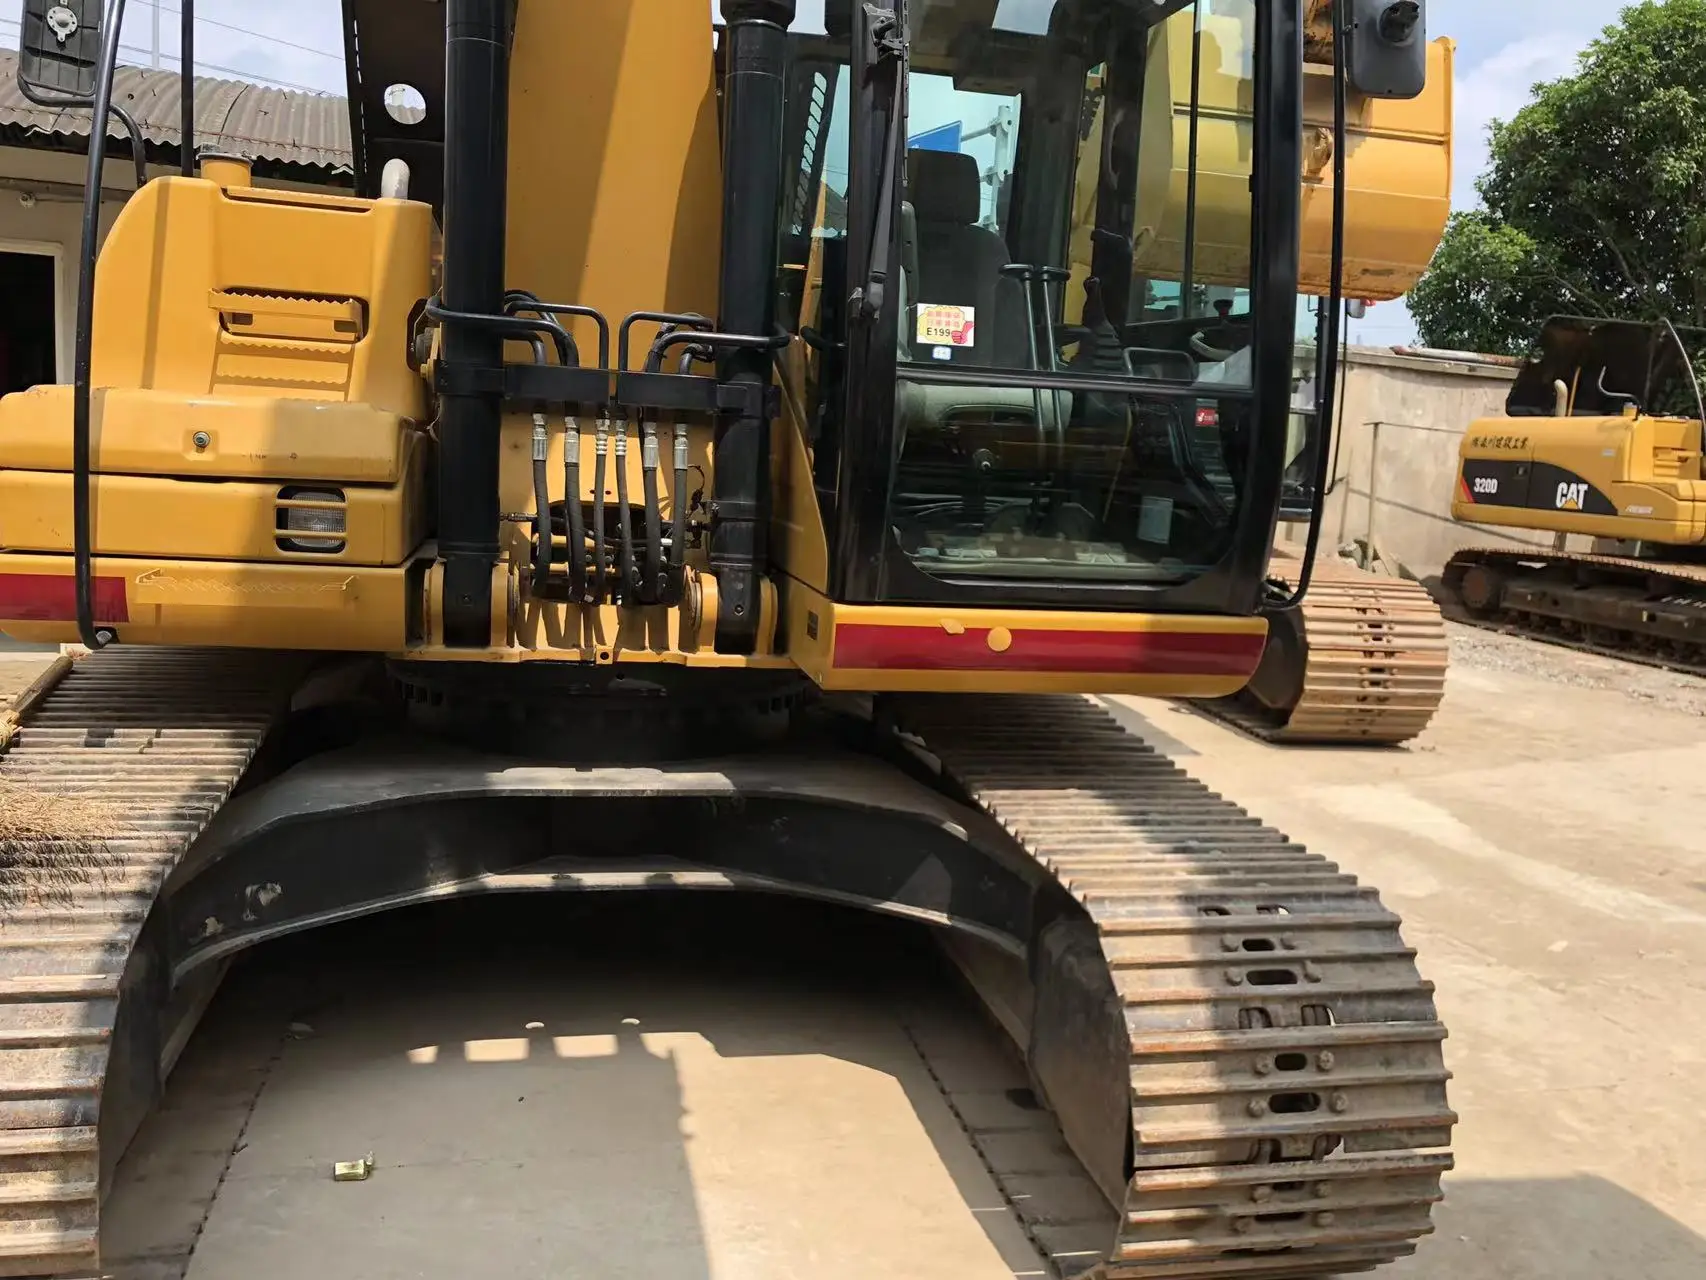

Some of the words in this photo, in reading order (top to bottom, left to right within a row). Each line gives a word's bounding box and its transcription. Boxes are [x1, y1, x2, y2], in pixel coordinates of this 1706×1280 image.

[926, 327, 950, 337] E199
[1474, 477, 1498, 494] 320D
[1556, 481, 1589, 510] CAT
